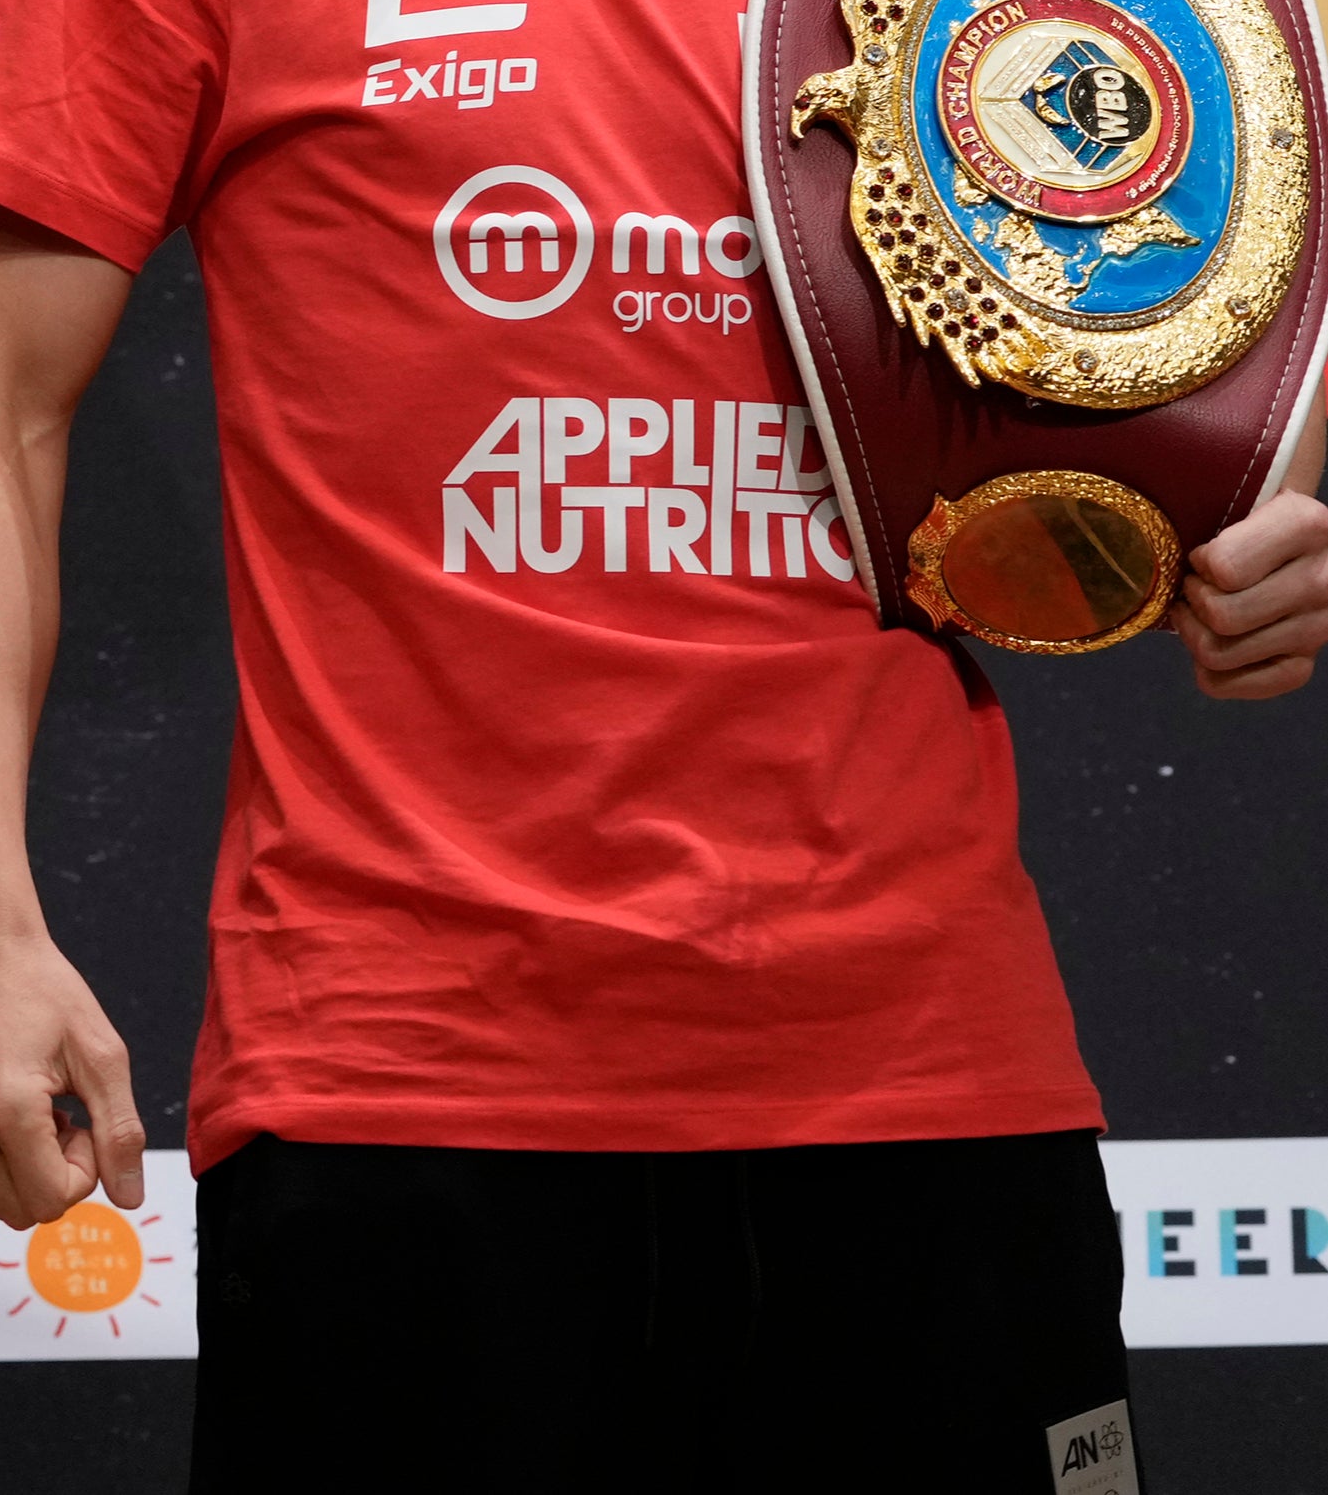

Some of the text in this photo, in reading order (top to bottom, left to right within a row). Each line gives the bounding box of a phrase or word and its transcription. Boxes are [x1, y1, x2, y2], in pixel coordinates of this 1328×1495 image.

[361, 50, 538, 110] Exigo
[947, 2, 1028, 120] CHAMPION
[1093, 69, 1130, 140] WBO
[958, 126, 1042, 207] WORLD
[613, 290, 752, 335] group
[443, 397, 831, 492] APPLIED
[1061, 1430, 1099, 1477] AN
